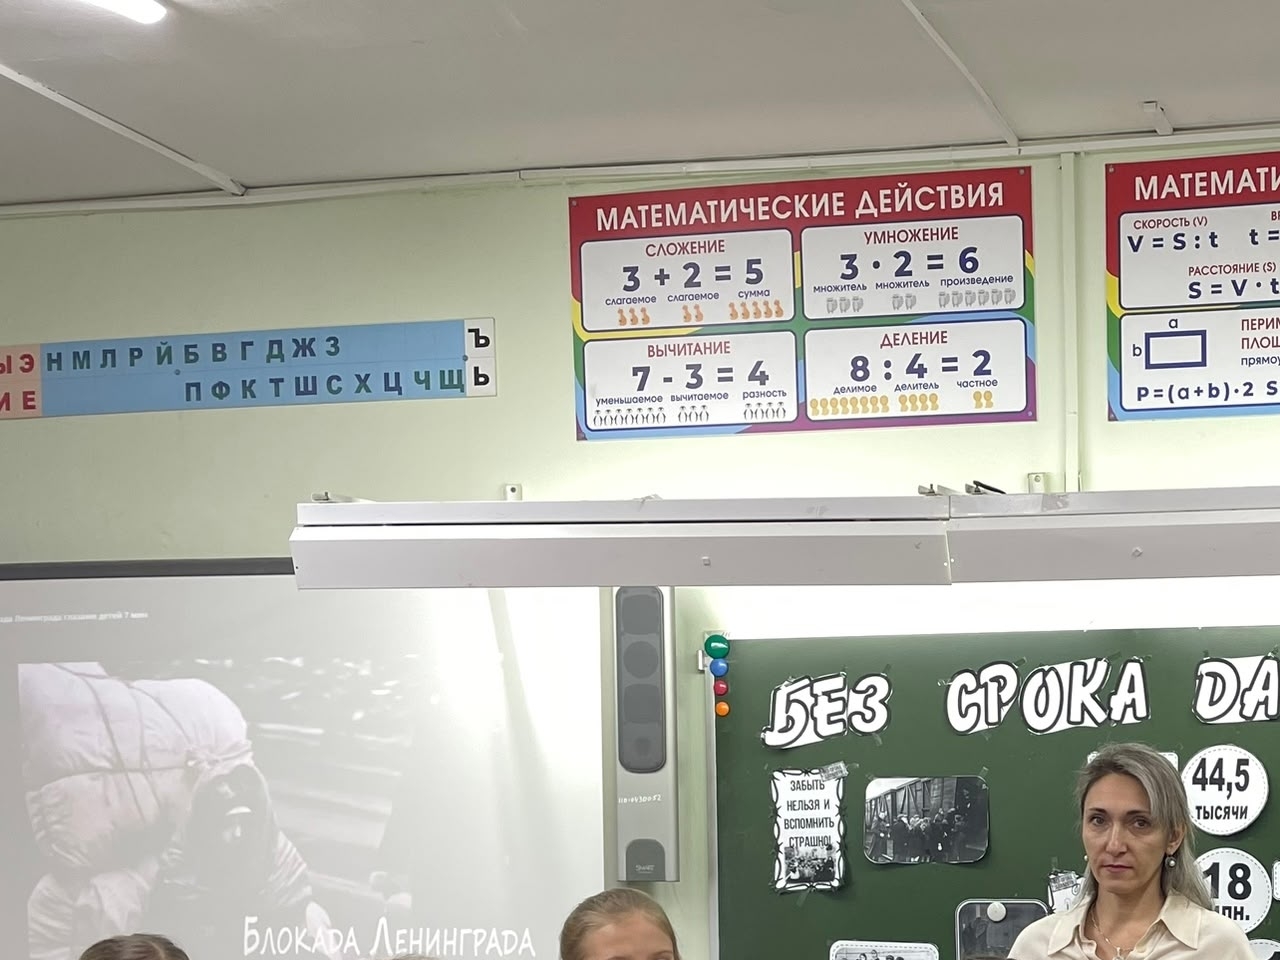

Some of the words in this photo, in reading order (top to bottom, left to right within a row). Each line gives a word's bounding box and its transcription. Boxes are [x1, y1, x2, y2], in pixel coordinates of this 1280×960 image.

[596, 194, 845, 231] МАТЕМАТИЧЕСКИЕ
[855, 183, 1004, 218] ДЕЙСТВИЯ
[1134, 217, 1189, 229] СКОРОСТЬ
[1193, 216, 1208, 227] (V)
[864, 226, 958, 246] УМНОЖЕНИЕ
[646, 239, 725, 257] СЛОЖЕНИЕ
[1188, 263, 1258, 276] РАССТОЯНИЕ
[1262, 261, 1276, 273] (S)
[813, 282, 867, 293] множитель
[875, 278, 930, 290] множитель
[940, 274, 1014, 286] произведение
[605, 295, 657, 306] слагаемое
[667, 291, 719, 303] слагаемое
[738, 288, 770, 299] сумма
[880, 330, 947, 349] ДЕЛЕНИЕ
[647, 341, 731, 358] ВЫЧИТАНИЕ
[833, 384, 877, 395] делимое
[894, 381, 940, 392] делитель
[957, 378, 998, 388] частное
[596, 394, 663, 406] уменьшаемое
[670, 391, 729, 402] вычитаемое
[742, 388, 787, 399] разность
[761, 672, 893, 749] БЕЗ
[945, 657, 1151, 735] СРОКА
[790, 779, 825, 791] ЗАБЫТЬ
[1192, 758, 1250, 800] 44,5
[787, 799, 820, 811] НЕЛЬЗЯ
[824, 799, 830, 809] И
[784, 817, 834, 829] ВСПОМНИТЬ
[1202, 862, 1252, 900] 18
